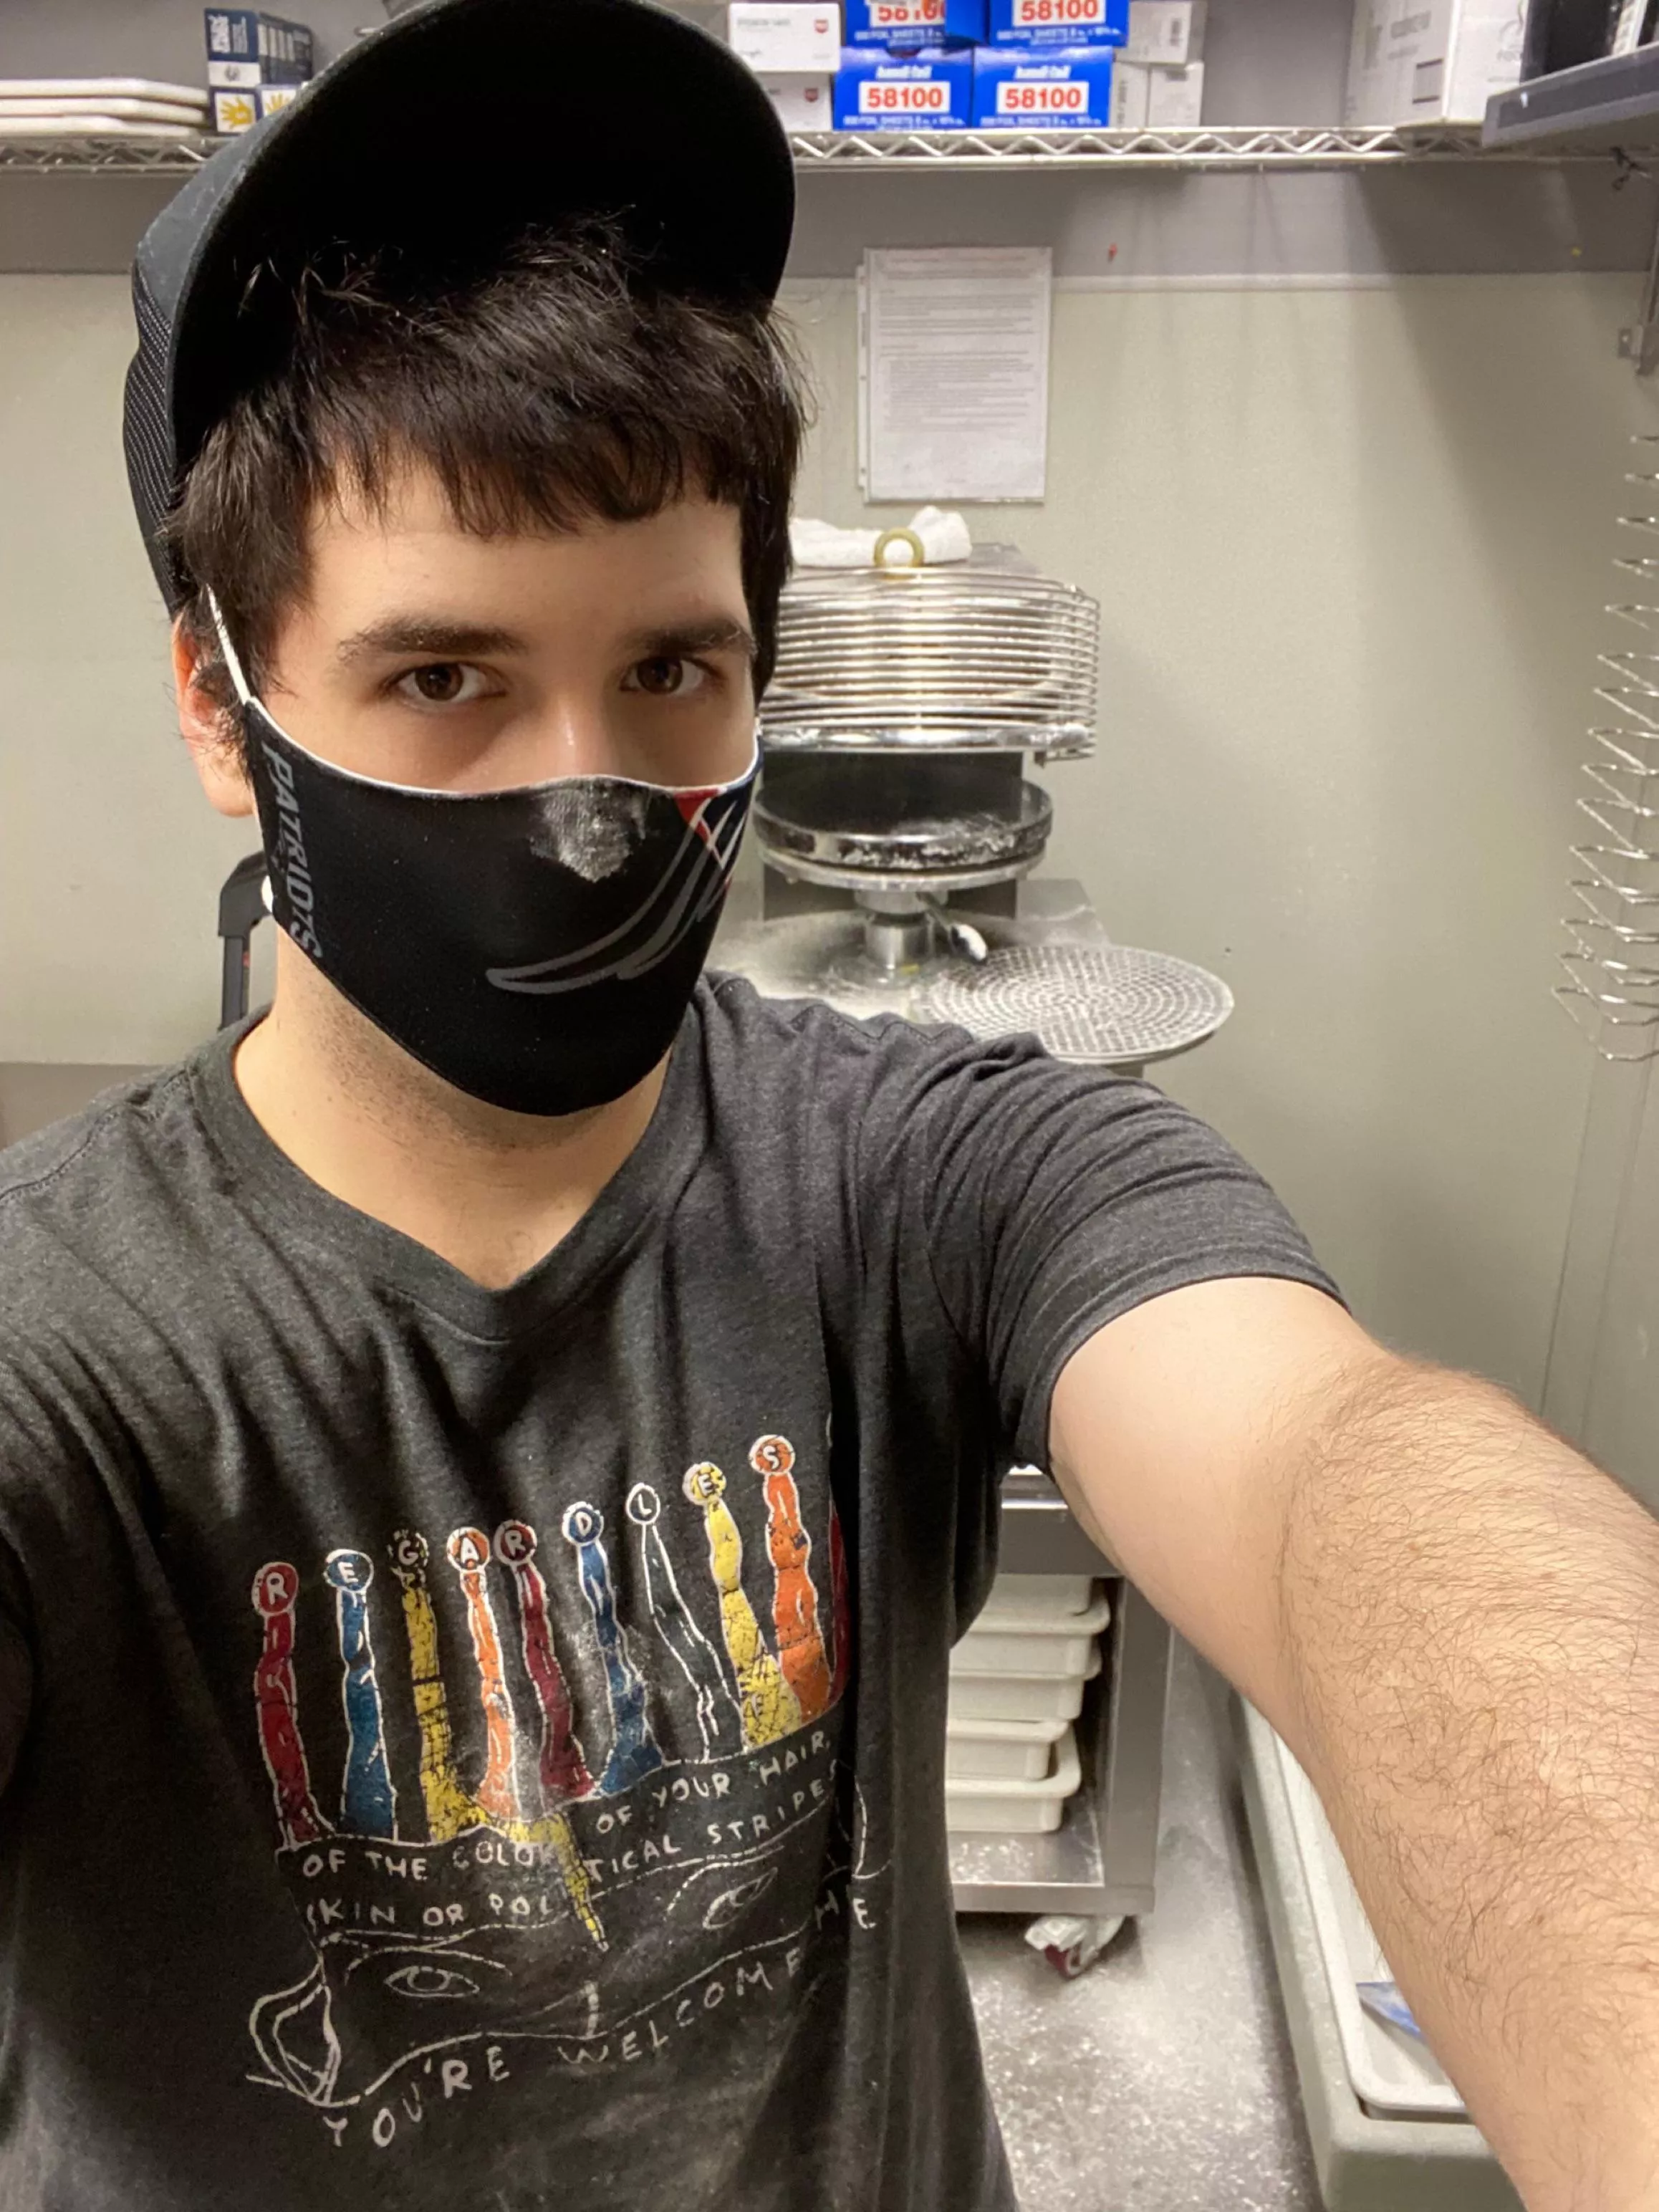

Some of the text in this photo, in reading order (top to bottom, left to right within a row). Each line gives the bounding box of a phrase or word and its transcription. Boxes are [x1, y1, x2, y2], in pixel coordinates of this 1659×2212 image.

[867, 87, 943, 108] 58100
[1005, 87, 1082, 108] 58100
[260, 740, 322, 958] PATRIOTS
[596, 1804, 633, 1834] OF
[651, 1772, 731, 1809] YOUR
[302, 1849, 346, 1877] OF
[365, 1851, 428, 1881] THE
[423, 1903, 464, 1926] OR
[557, 1946, 801, 2064] WELCOME
